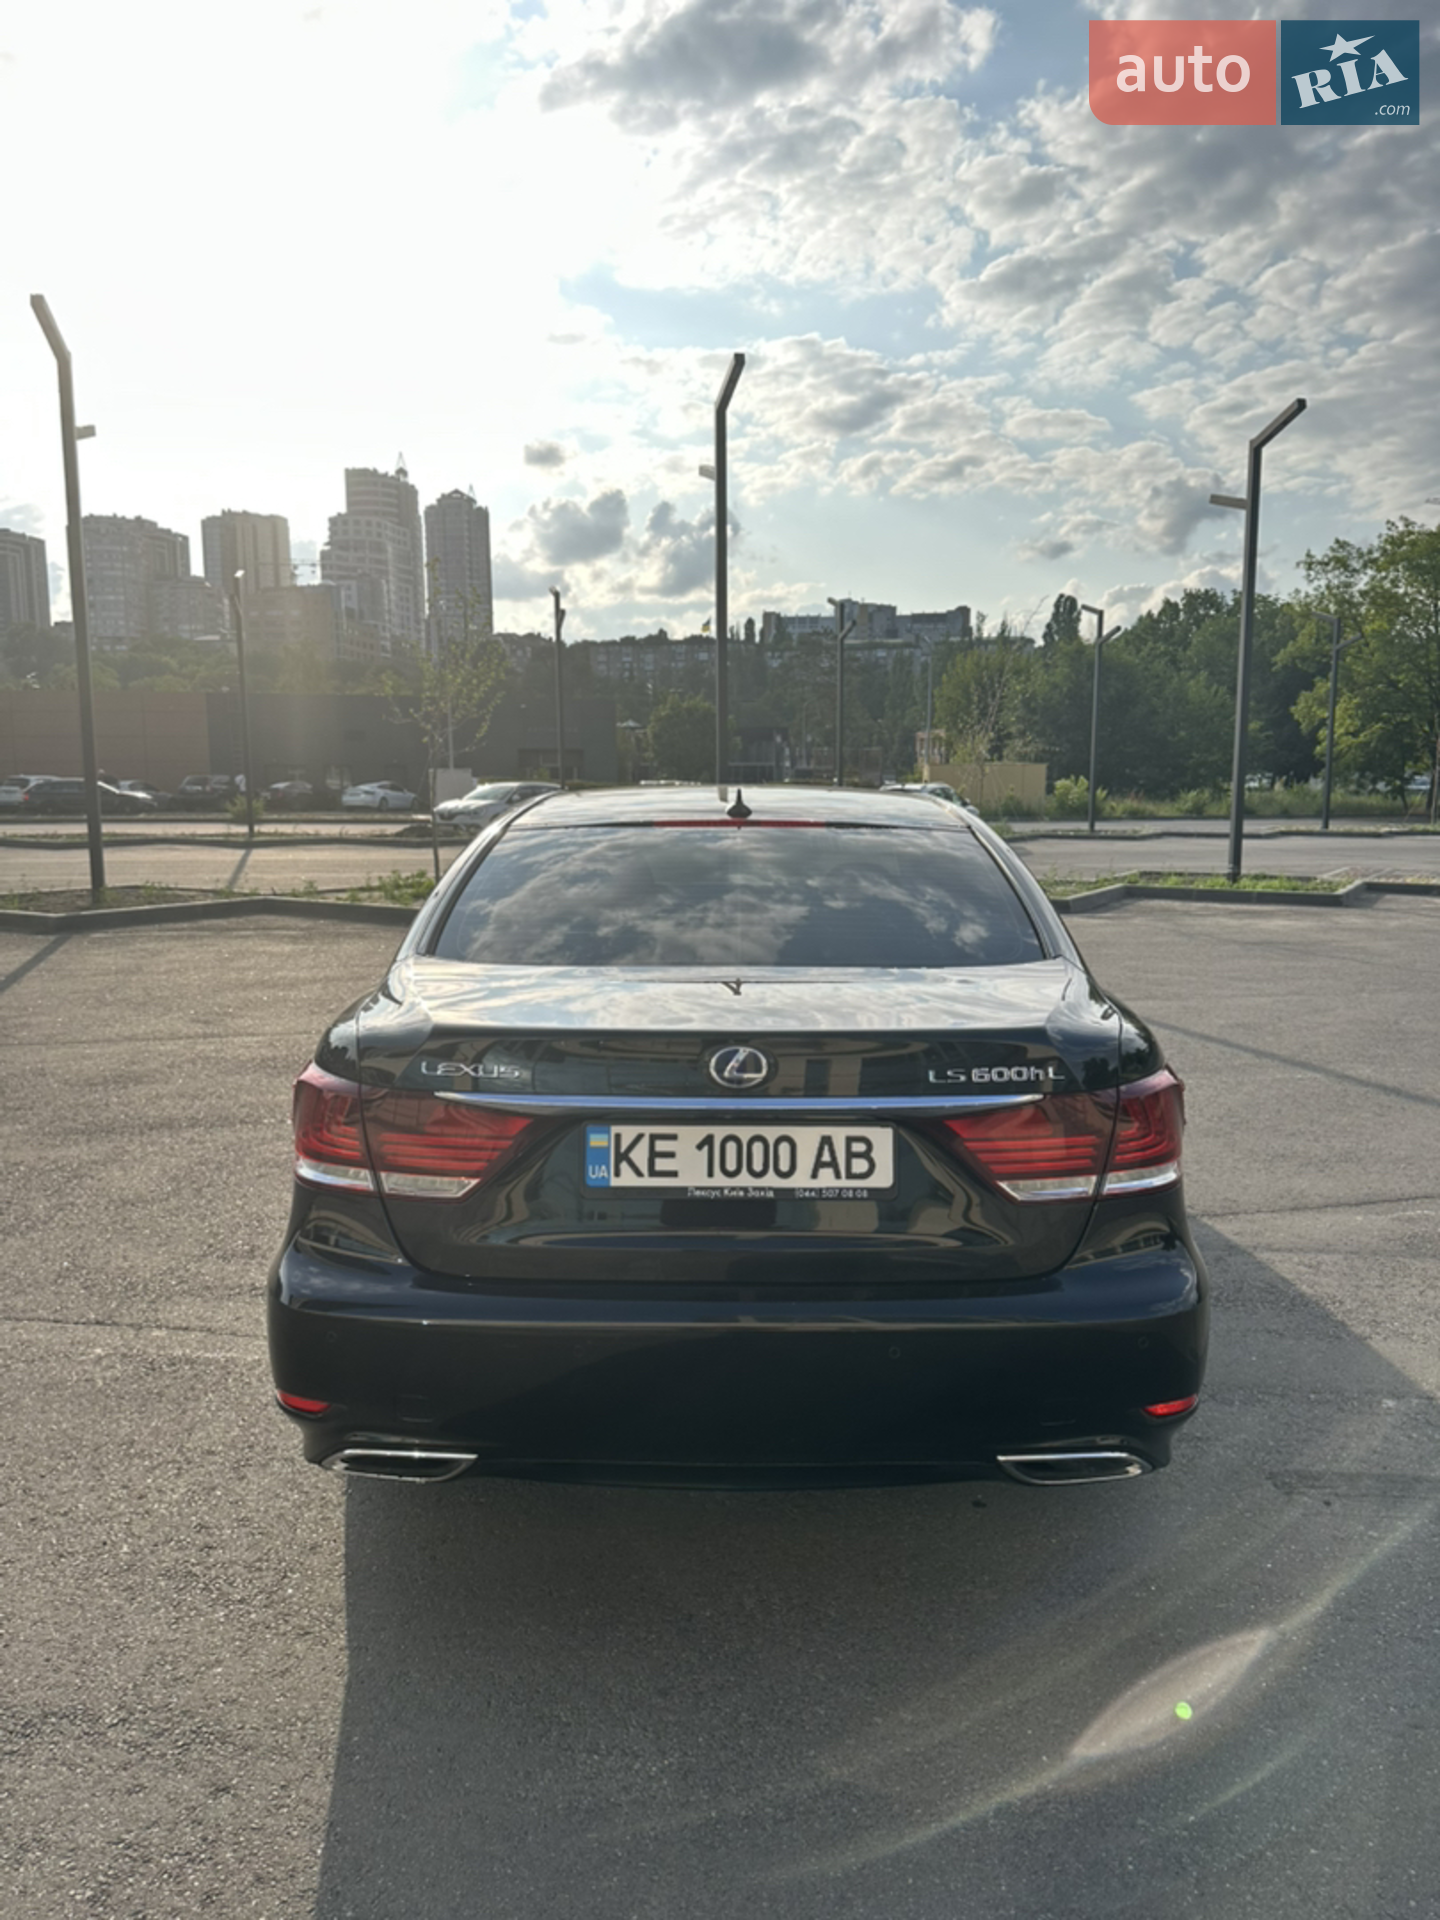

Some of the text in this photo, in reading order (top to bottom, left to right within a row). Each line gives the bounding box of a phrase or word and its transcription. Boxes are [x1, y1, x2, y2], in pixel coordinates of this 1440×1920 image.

[421, 1061, 520, 1078] LEXUS
[928, 1069, 967, 1083] LS
[613, 1132, 876, 1180] KE 1000 AB
[588, 1164, 609, 1179] UA
